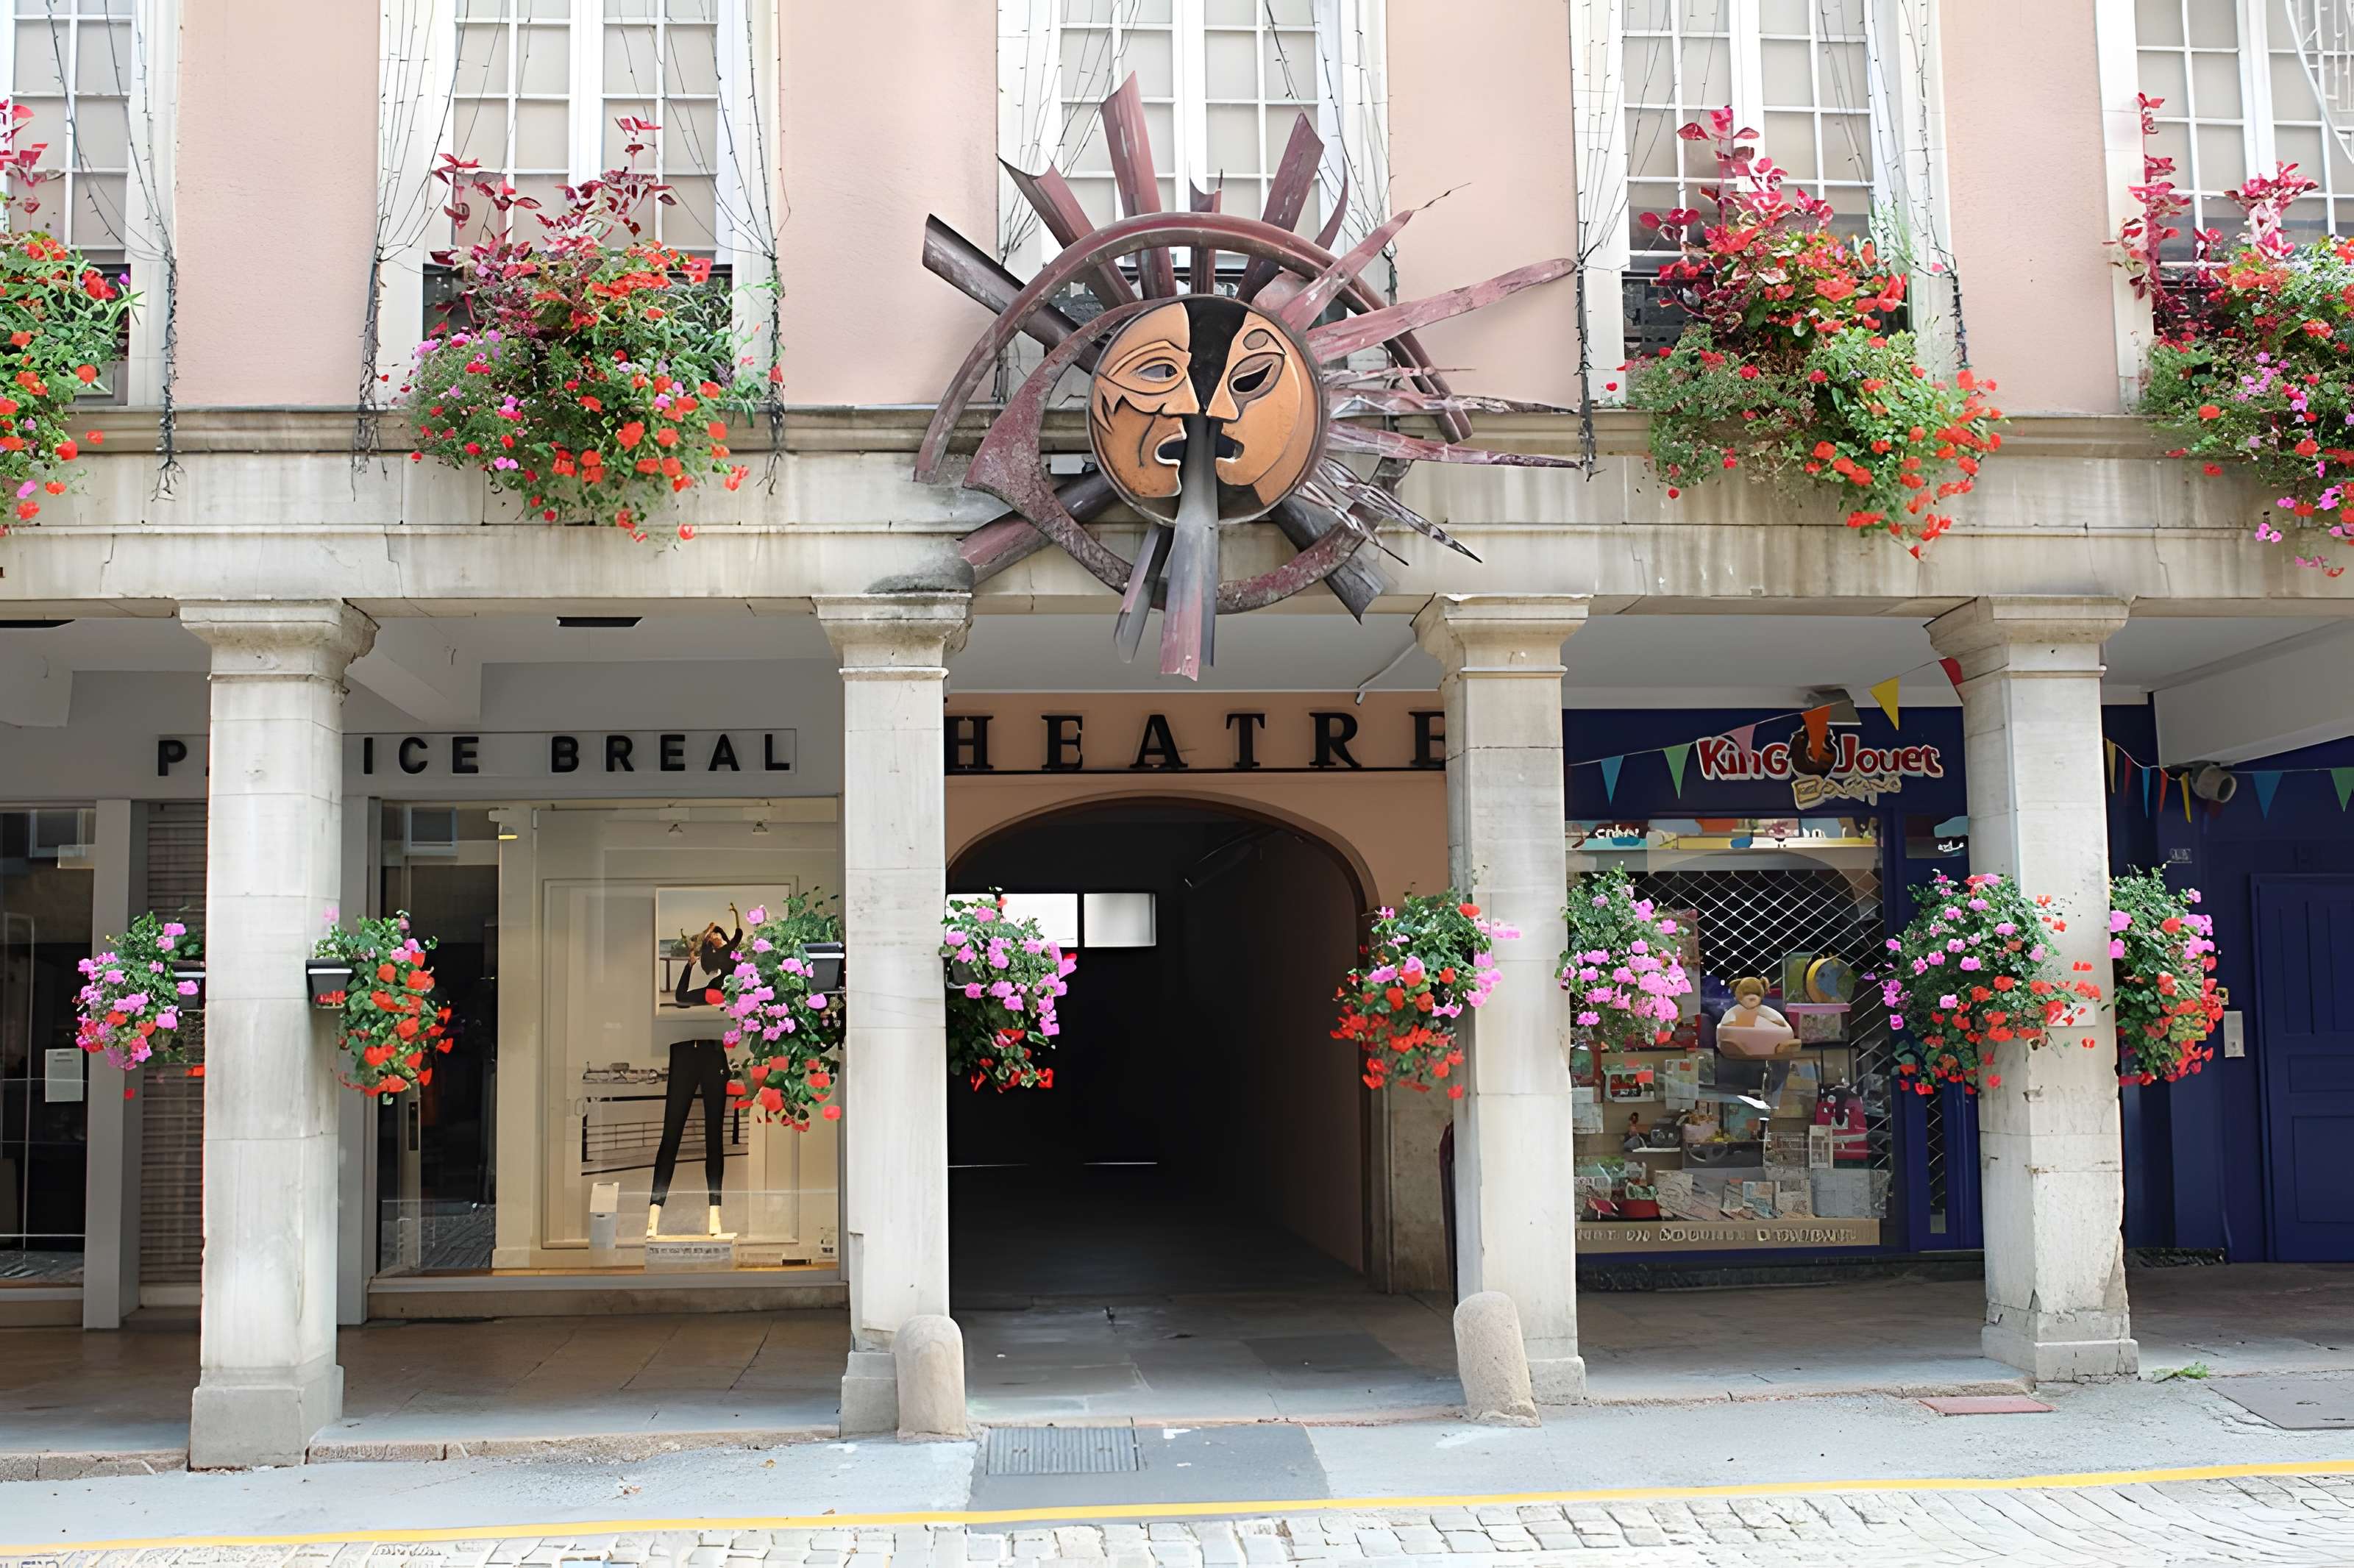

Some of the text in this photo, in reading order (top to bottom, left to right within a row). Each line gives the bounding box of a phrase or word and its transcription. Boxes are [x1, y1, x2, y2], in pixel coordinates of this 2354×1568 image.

[157, 733, 791, 777] PICE BREAL
[945, 712, 1446, 770] HEATRE
[1833, 734, 1944, 777] Jouet
